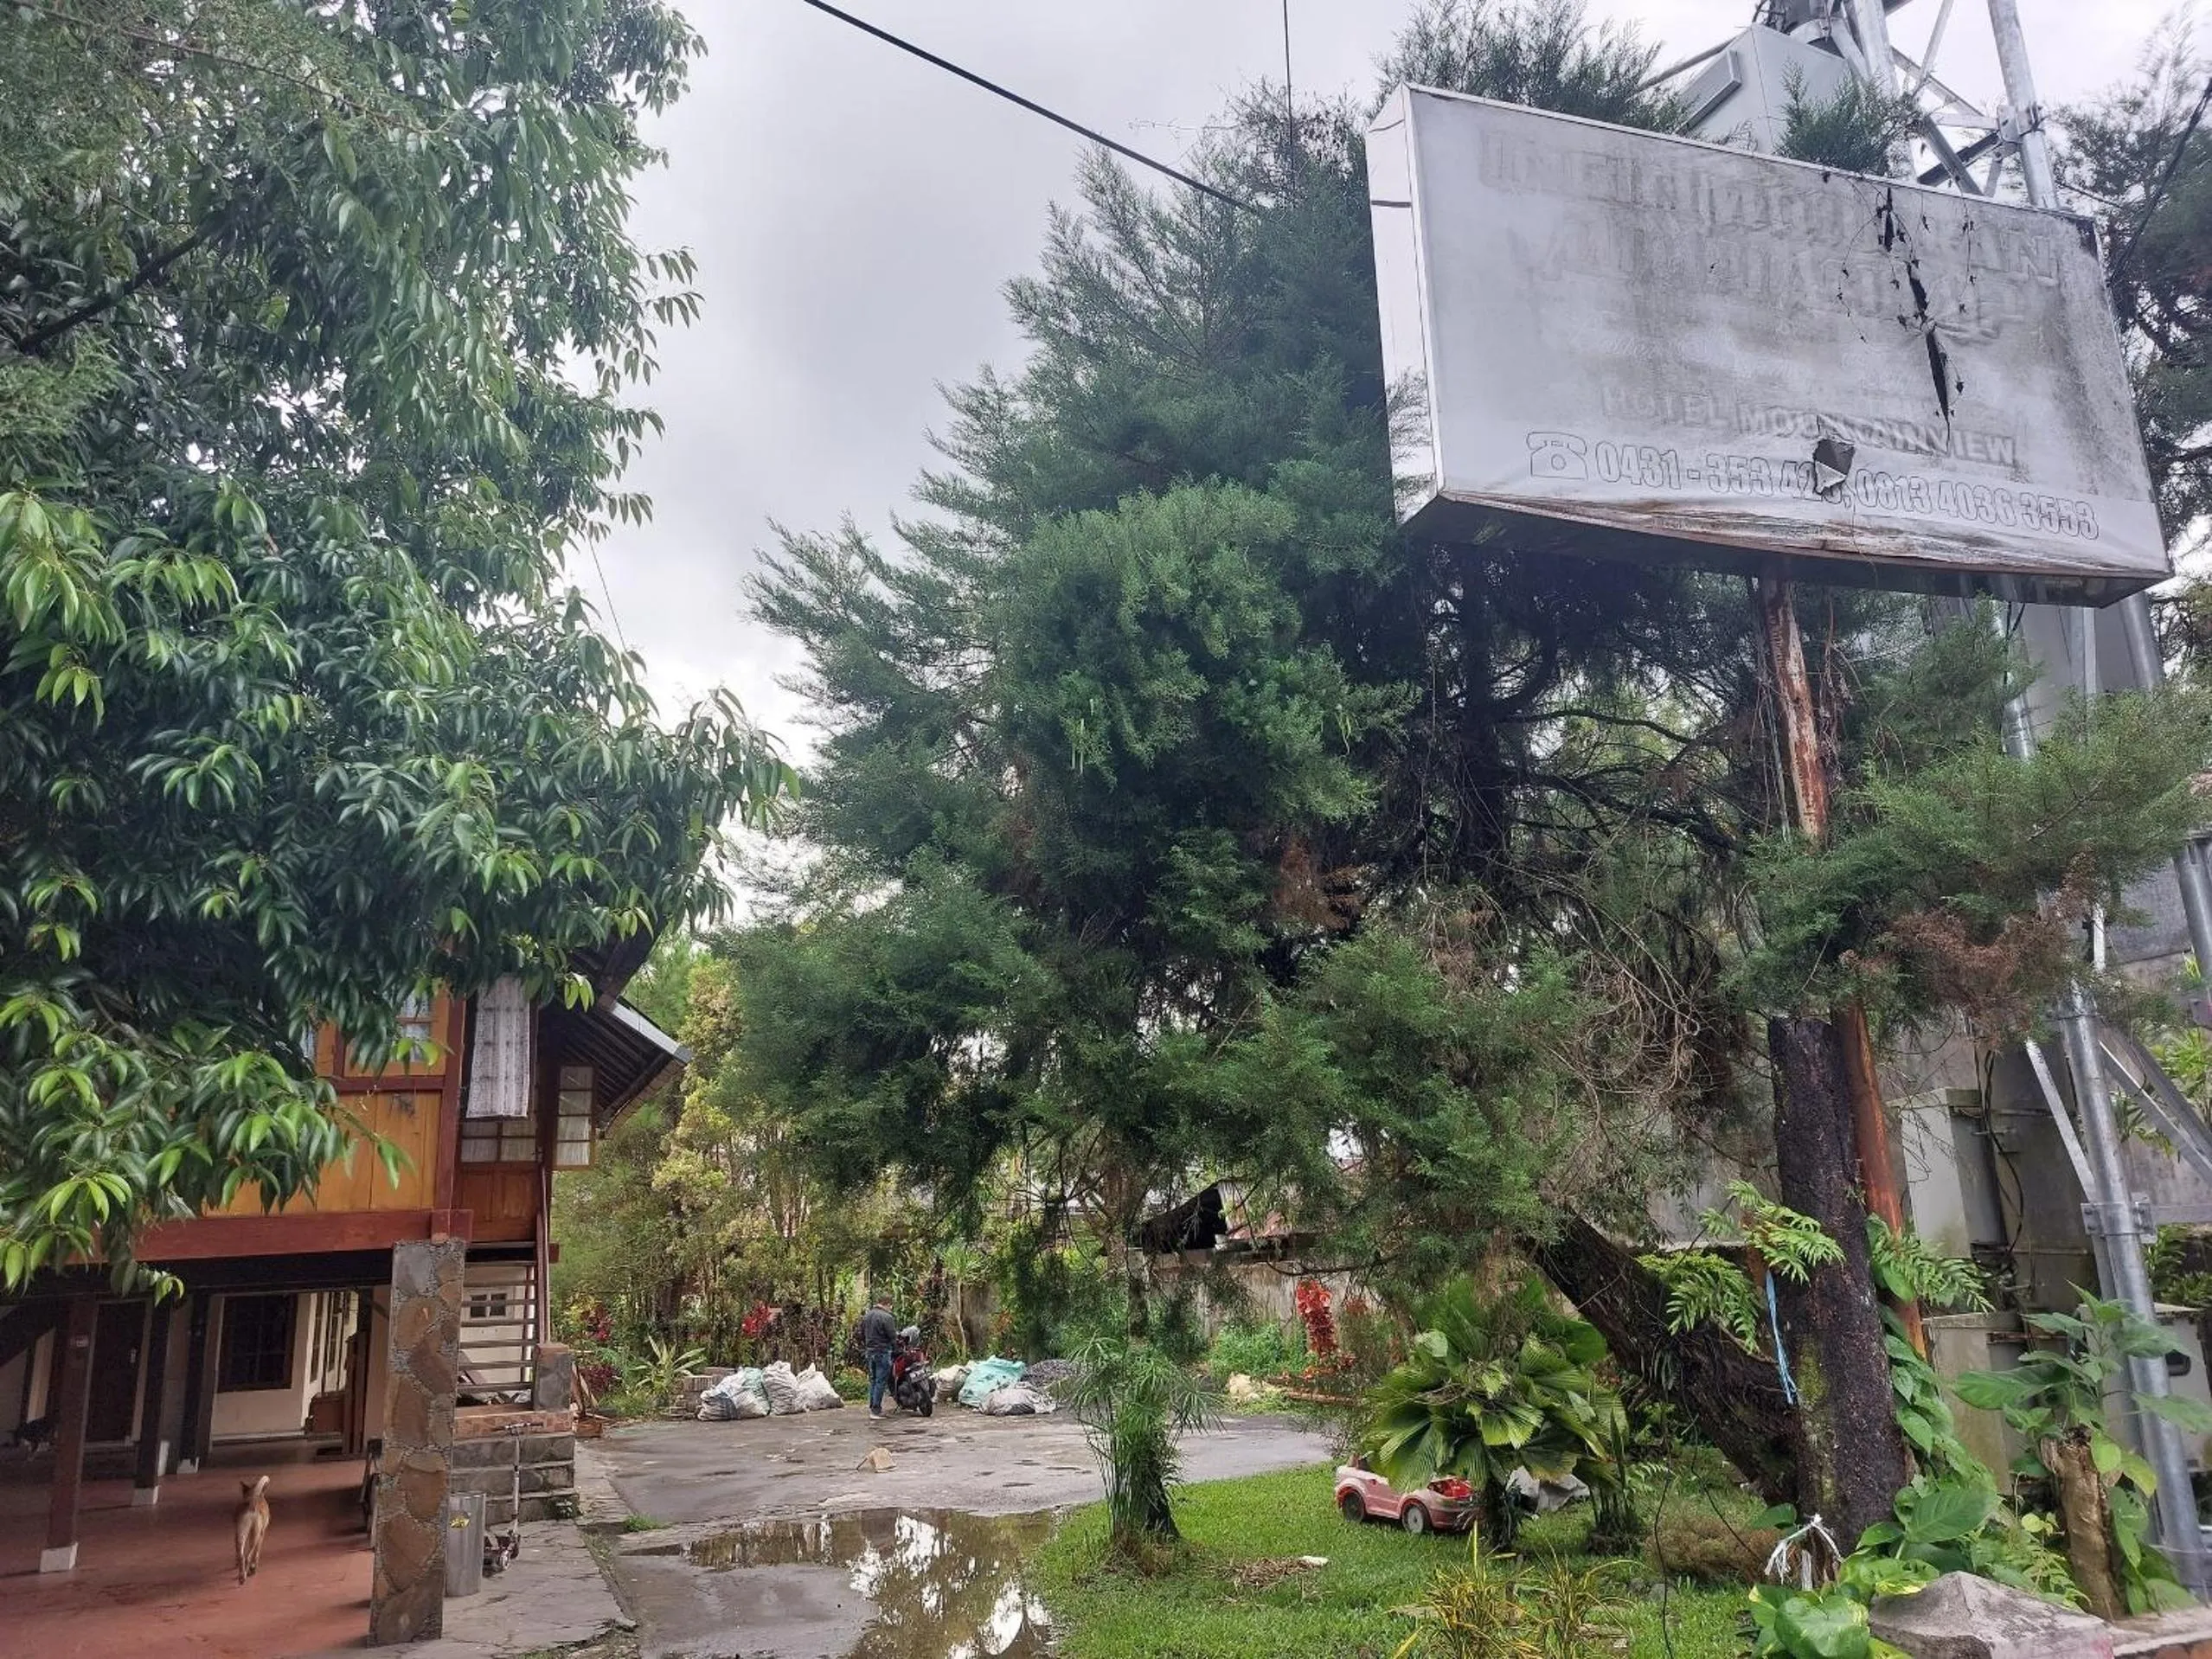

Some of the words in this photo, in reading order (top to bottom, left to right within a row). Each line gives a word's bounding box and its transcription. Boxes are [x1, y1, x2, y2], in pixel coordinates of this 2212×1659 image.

[1601, 387, 1732, 429] HOTEL
[1595, 441, 1681, 490] 0431
[1706, 453, 1774, 497] 353
[1855, 468, 1933, 515] 0813
[1938, 480, 2016, 527] 4036
[2020, 492, 2100, 541] 3553
